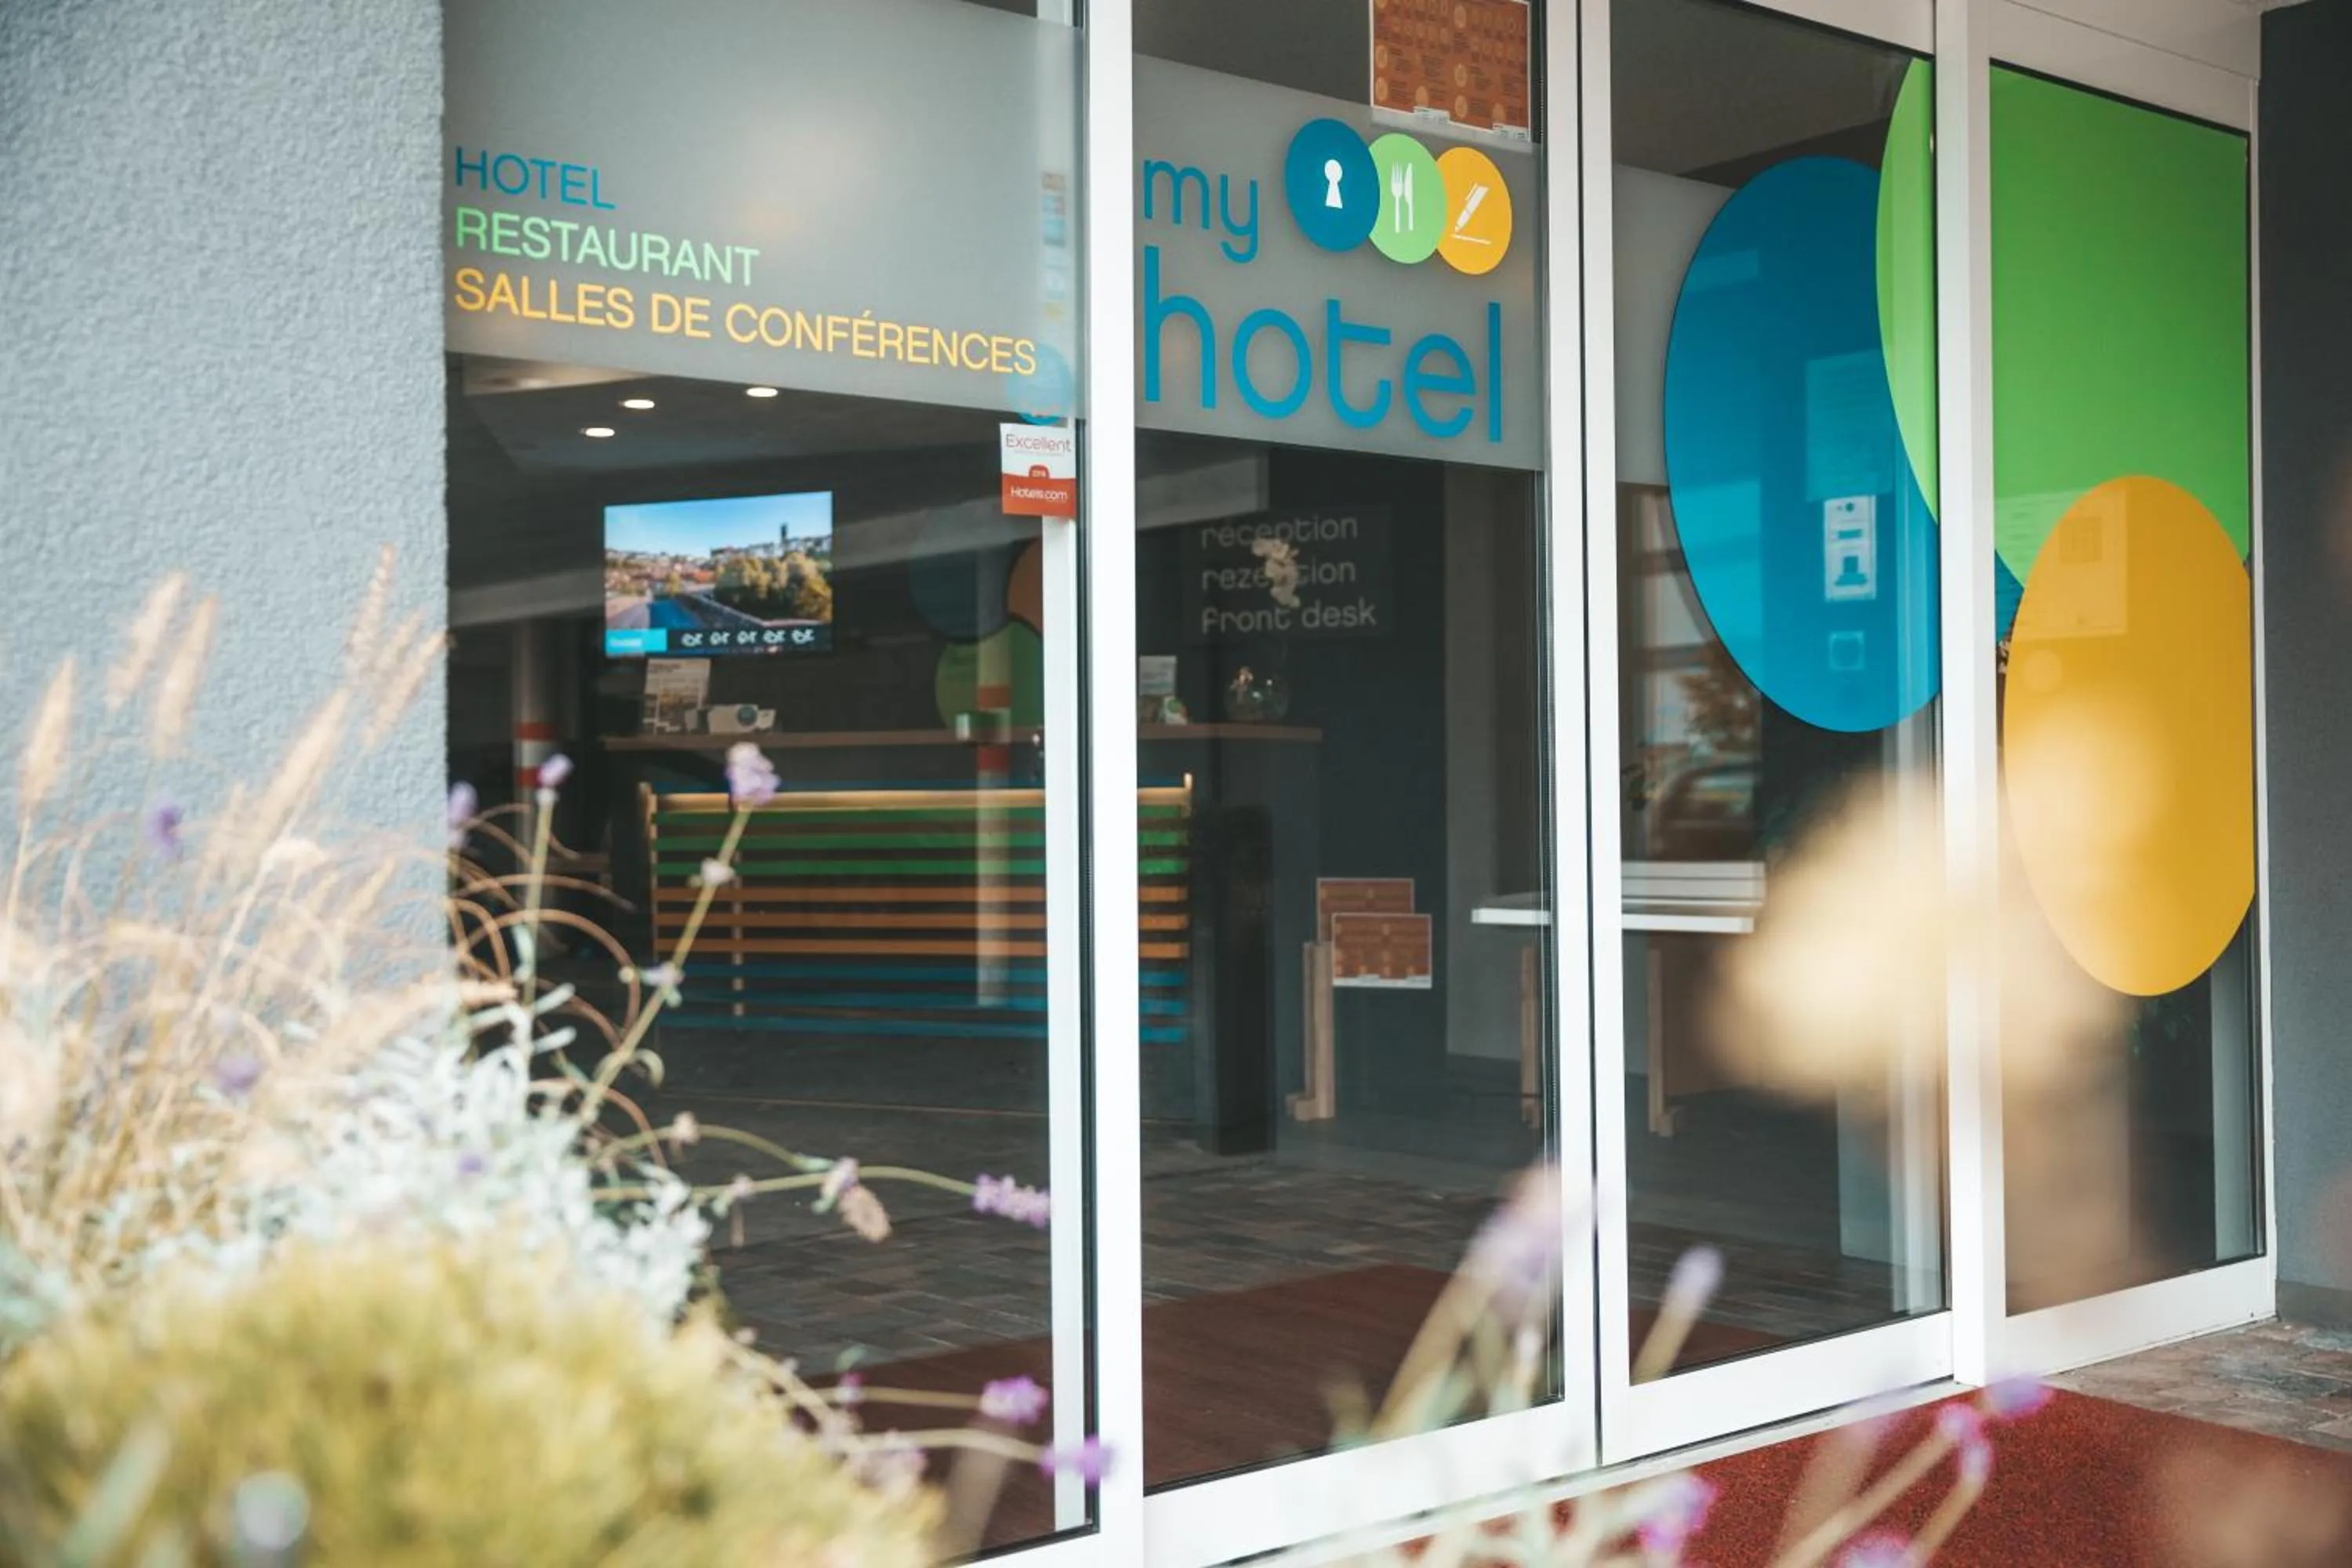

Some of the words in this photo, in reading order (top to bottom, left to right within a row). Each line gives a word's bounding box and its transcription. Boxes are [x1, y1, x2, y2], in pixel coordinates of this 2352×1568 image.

[456, 146, 616, 210] HOTEL
[1144, 159, 1258, 263] my
[457, 207, 760, 287] RESTAURANT
[455, 267, 635, 328] SALLES
[651, 292, 712, 339] DE
[724, 310, 1036, 376] CONFÉRENCES
[1144, 245, 1502, 443] hotel
[1006, 434, 1072, 452] Excellent
[1201, 606, 1292, 634] front
[1301, 596, 1377, 630] desk
